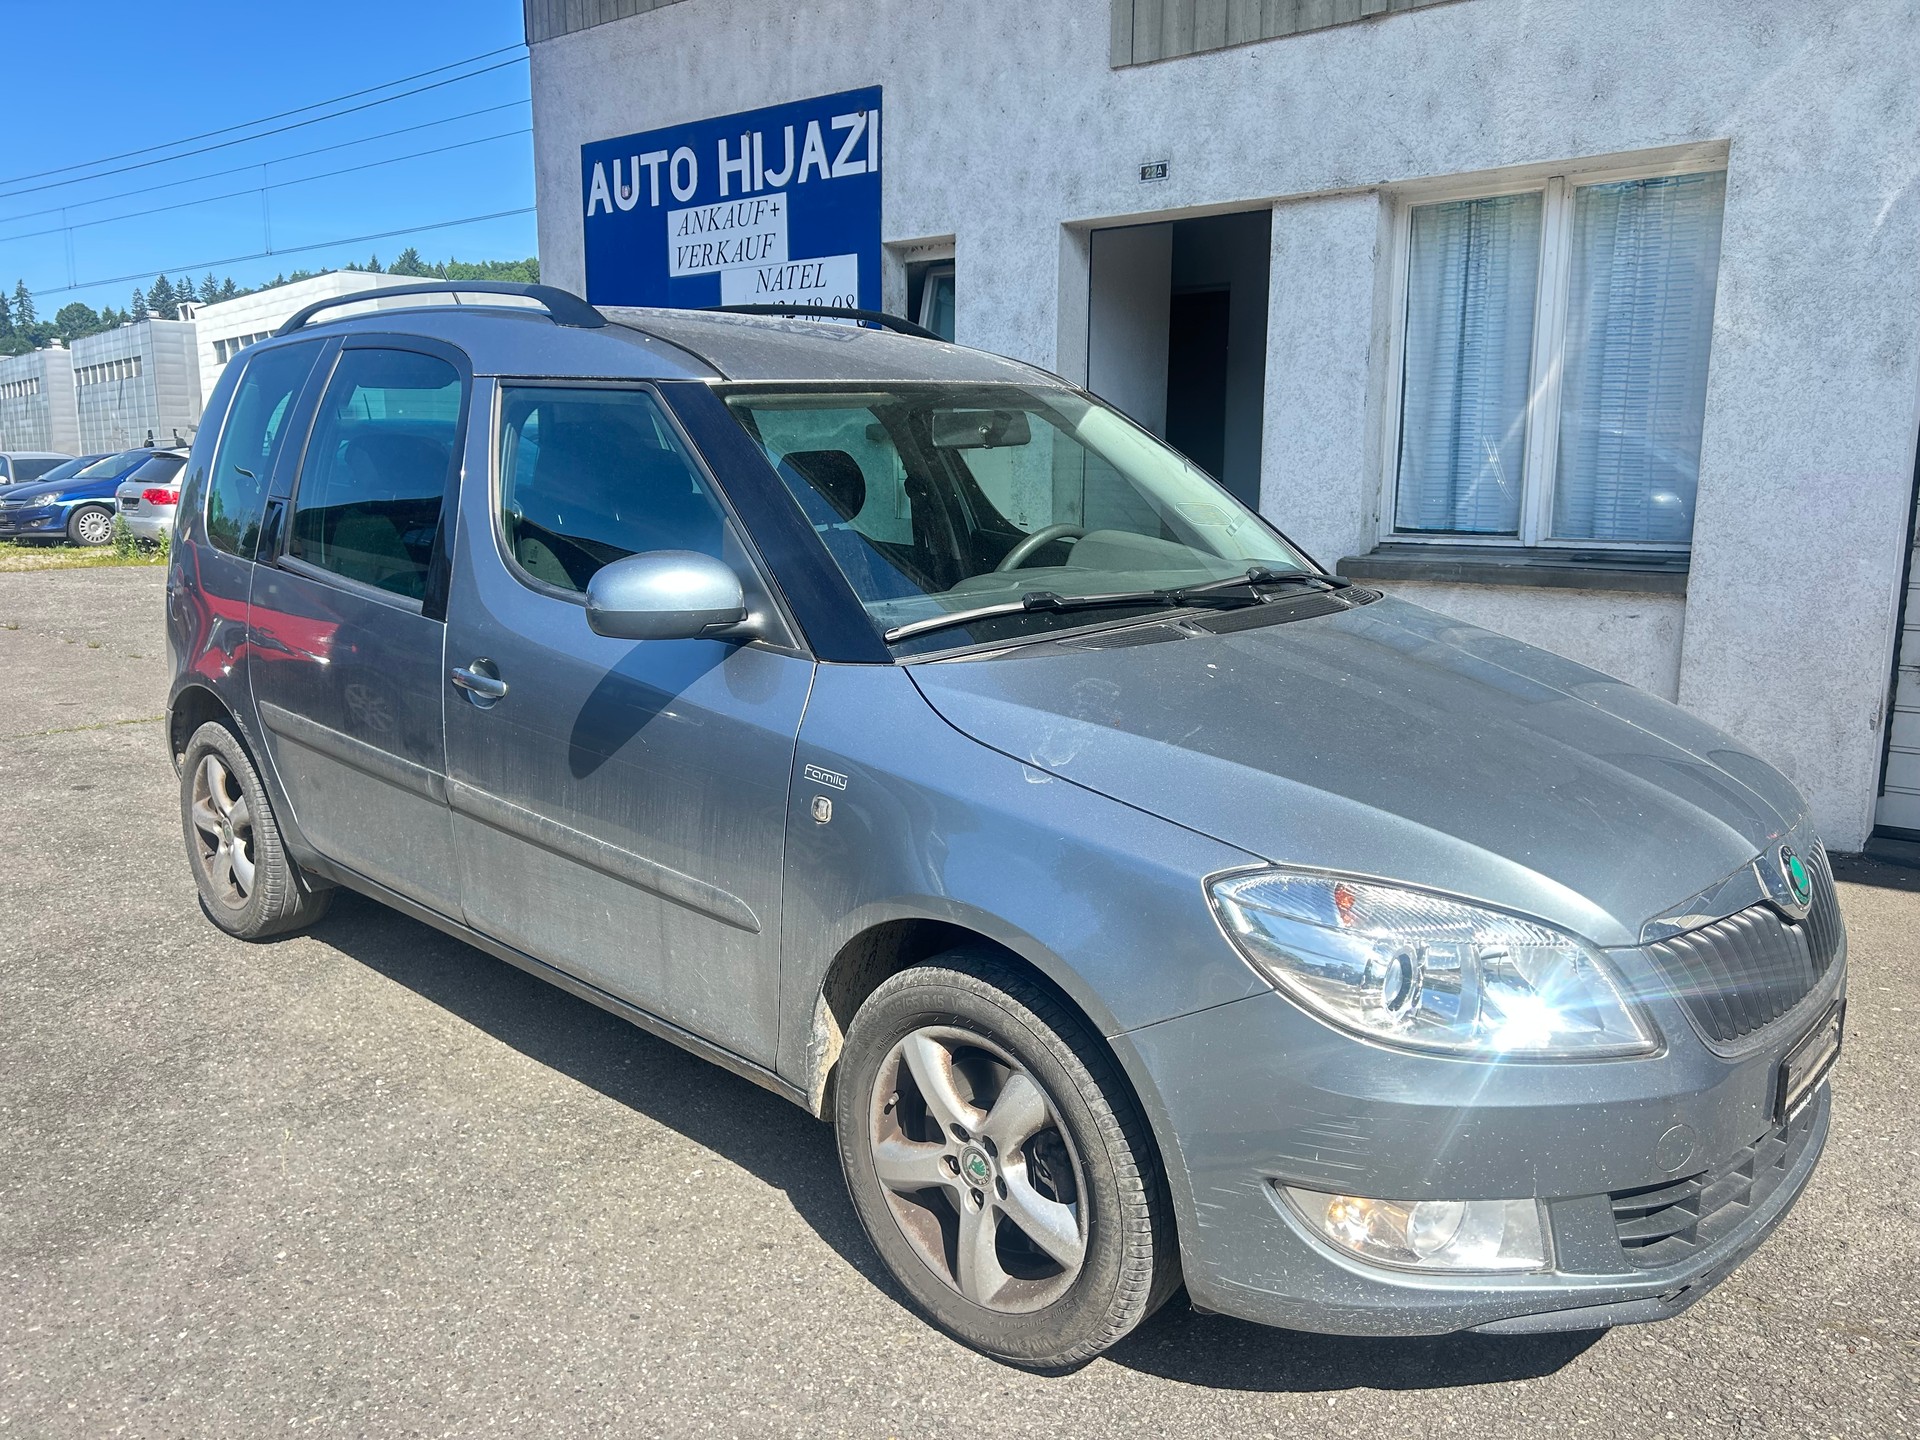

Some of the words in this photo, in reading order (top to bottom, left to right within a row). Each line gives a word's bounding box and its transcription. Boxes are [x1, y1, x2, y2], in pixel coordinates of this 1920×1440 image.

[587, 146, 698, 216] AUTO
[718, 110, 878, 197] HIJAZI
[676, 199, 780, 237] ANKAUF+
[676, 233, 776, 269] VERKAUF
[755, 262, 828, 294] NATEL
[804, 764, 848, 790] Family
